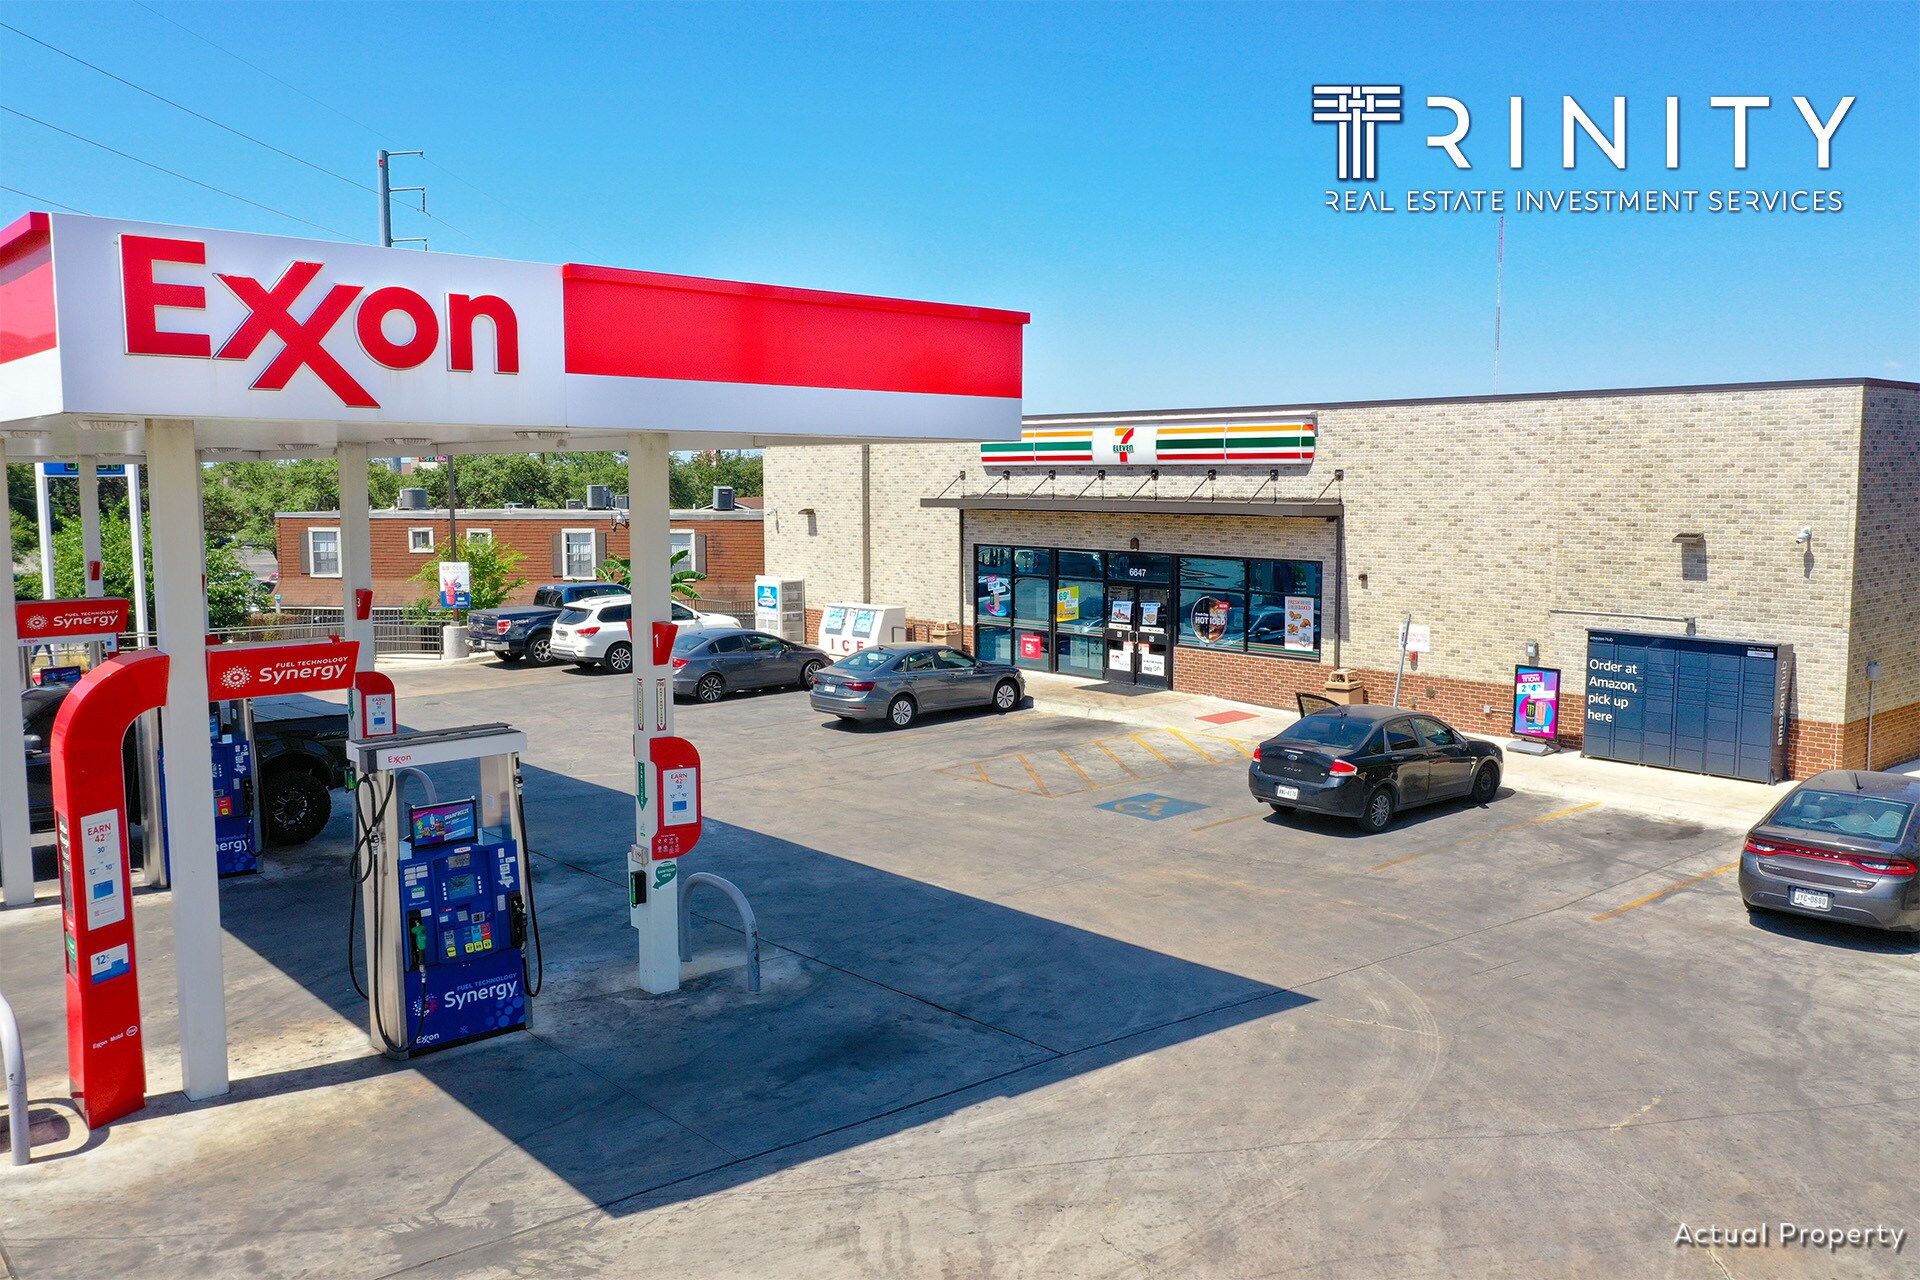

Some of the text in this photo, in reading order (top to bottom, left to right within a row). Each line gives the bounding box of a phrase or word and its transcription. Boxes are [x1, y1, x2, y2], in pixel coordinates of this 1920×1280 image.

[118, 233, 519, 408] Exxon
[1114, 427, 1134, 462] 7
[1129, 568, 1146, 577] 6647
[357, 597, 361, 607] 3
[53, 615, 119, 629] Synergy
[1195, 616, 1209, 625] HOT
[654, 634, 659, 648] 1
[831, 638, 864, 652] ICE
[297, 656, 349, 667] TECHNOLOGY
[1589, 659, 1638, 674] Order at
[259, 663, 347, 685] Synergy
[1588, 676, 1638, 694] Amazon,
[1588, 693, 1629, 709] pick up
[1777, 660, 1788, 746] amazon hub
[1587, 709, 1613, 722] here
[387, 755, 412, 764] Exxon
[87, 823, 111, 836] EARN
[457, 973, 518, 991] FUEL TECHNOLOGY
[444, 981, 518, 1010] Synergy
[416, 1033, 440, 1044] Exxon
